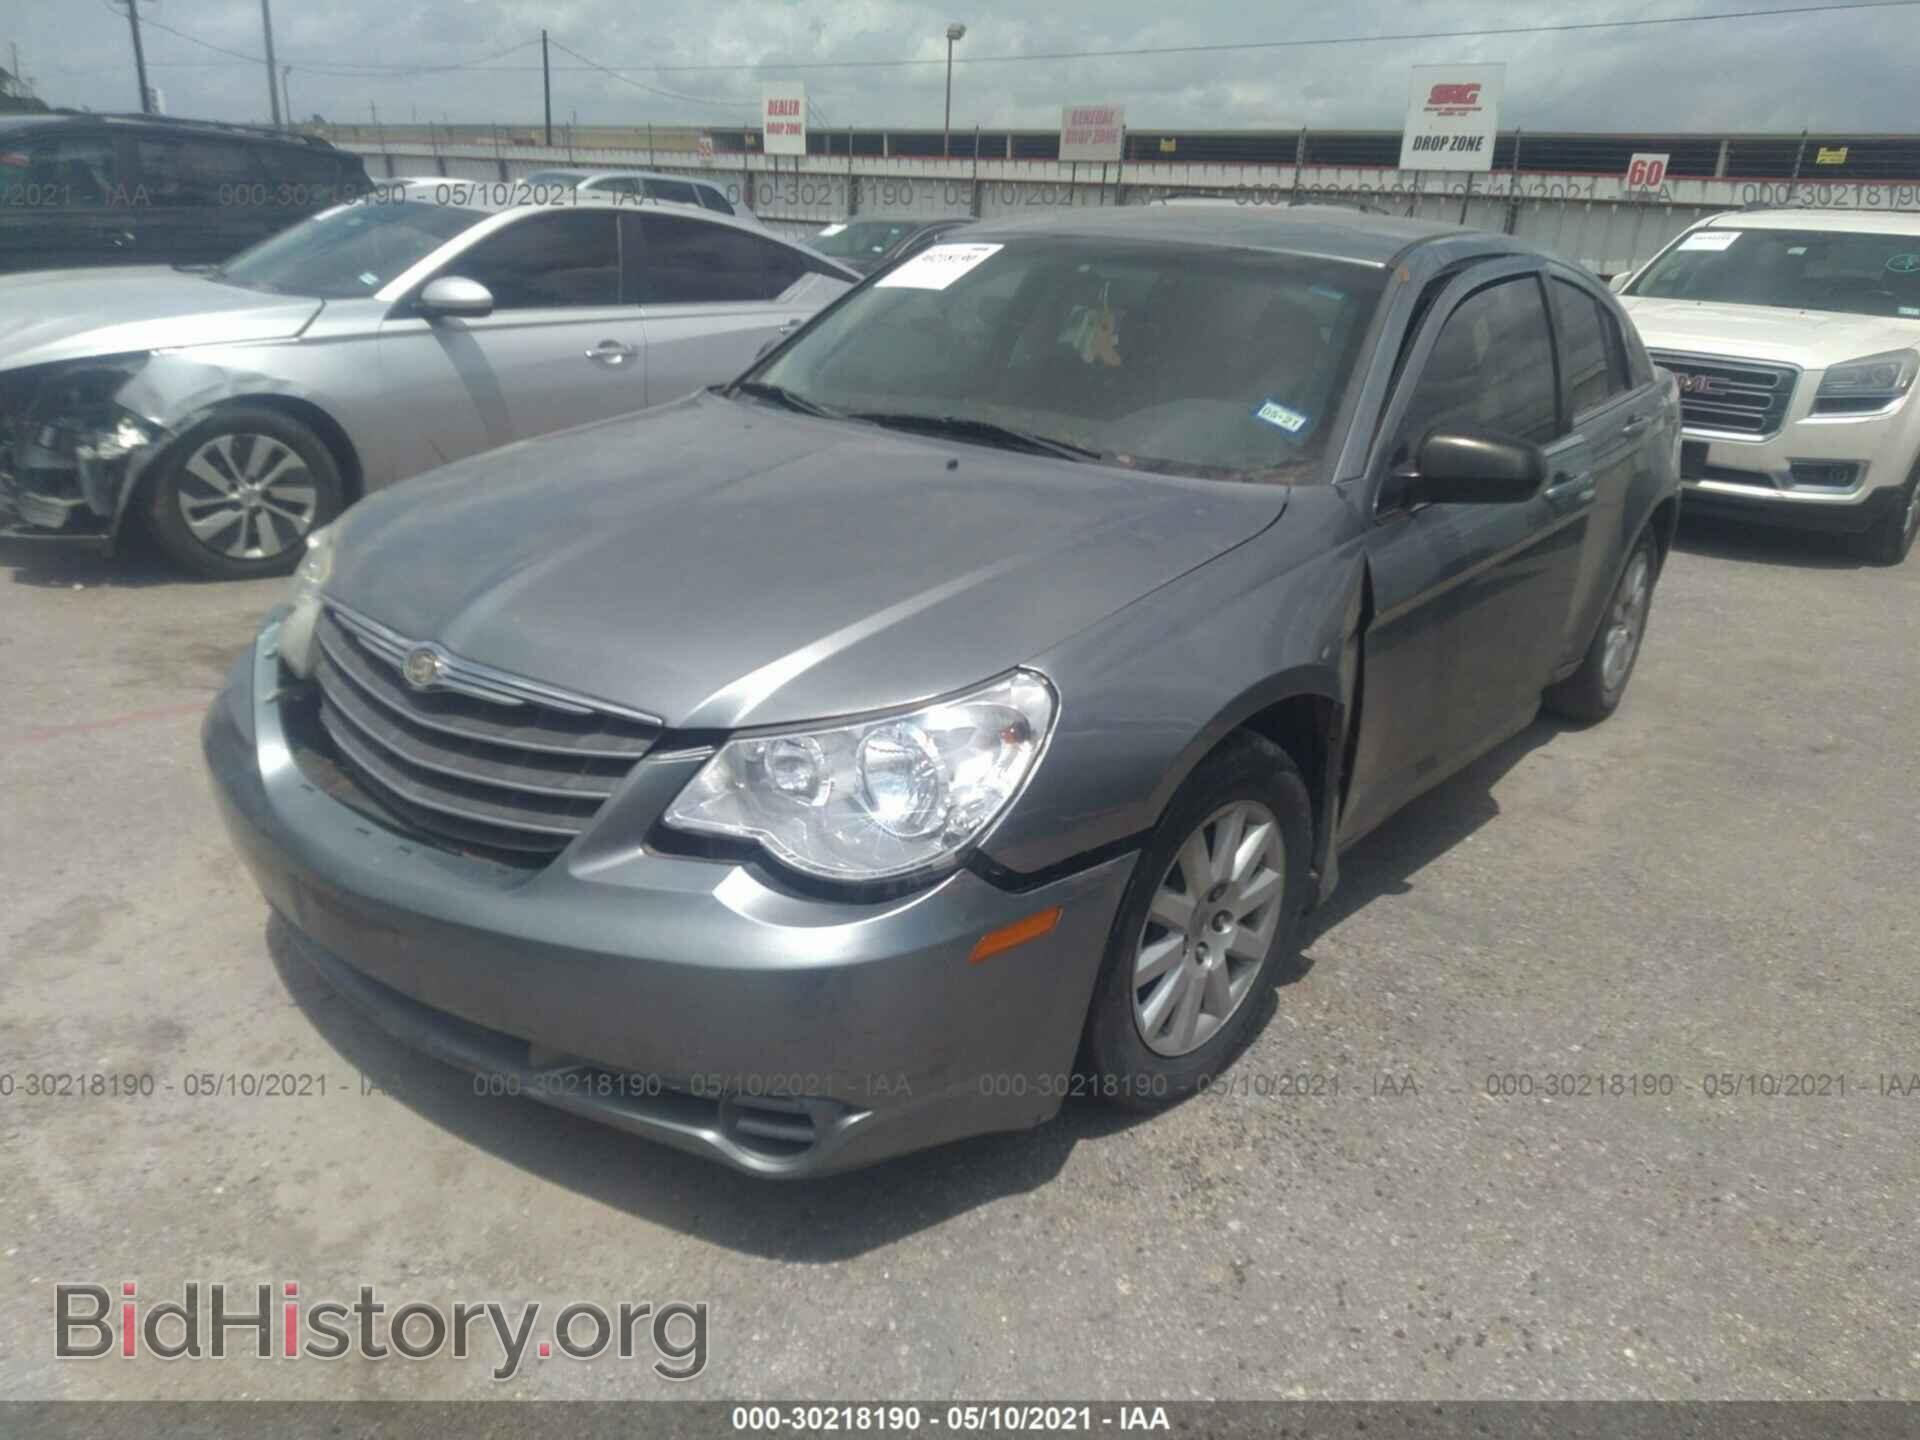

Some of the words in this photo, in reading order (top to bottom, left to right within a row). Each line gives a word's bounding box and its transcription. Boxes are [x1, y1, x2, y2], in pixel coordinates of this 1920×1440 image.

[768, 99, 800, 116] DEALER
[1412, 136, 1448, 151] DROP
[1450, 136, 1485, 151] ZONE
[1628, 159, 1664, 187] 60
